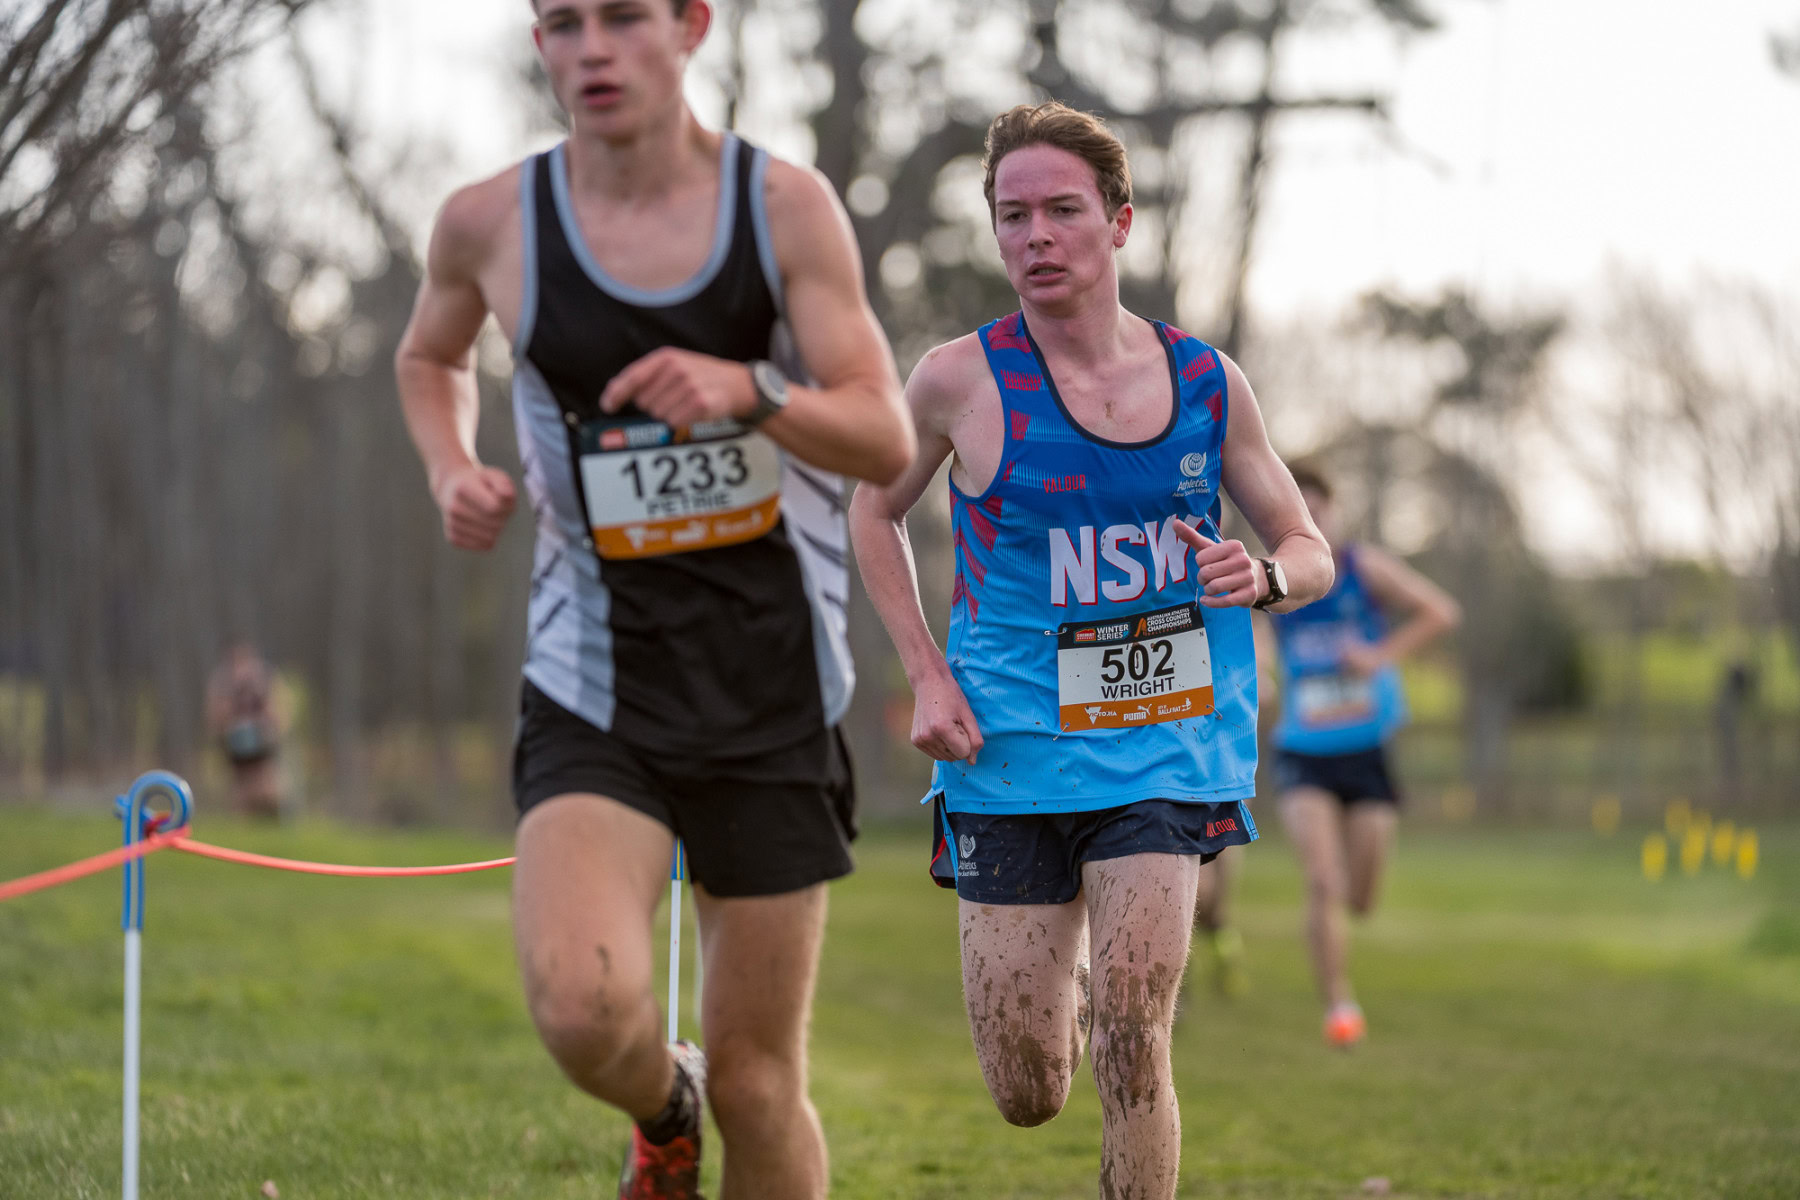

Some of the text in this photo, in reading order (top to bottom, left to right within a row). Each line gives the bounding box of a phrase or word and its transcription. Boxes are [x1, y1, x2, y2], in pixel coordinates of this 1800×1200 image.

[622, 446, 748, 498] 1233
[1043, 474, 1086, 494] VALOUR
[1177, 478, 1208, 491] Athletics
[1049, 513, 1205, 608] NSW
[1147, 612, 1190, 627] CROSS COUNTRY
[1147, 617, 1192, 633] CHAMPIONSHIPS
[1096, 623, 1129, 635] WINTER
[1097, 631, 1123, 641] SERIES
[1101, 639, 1175, 684] 502
[1101, 676, 1175, 700] WRIGHT
[1123, 711, 1147, 722] PUMA
